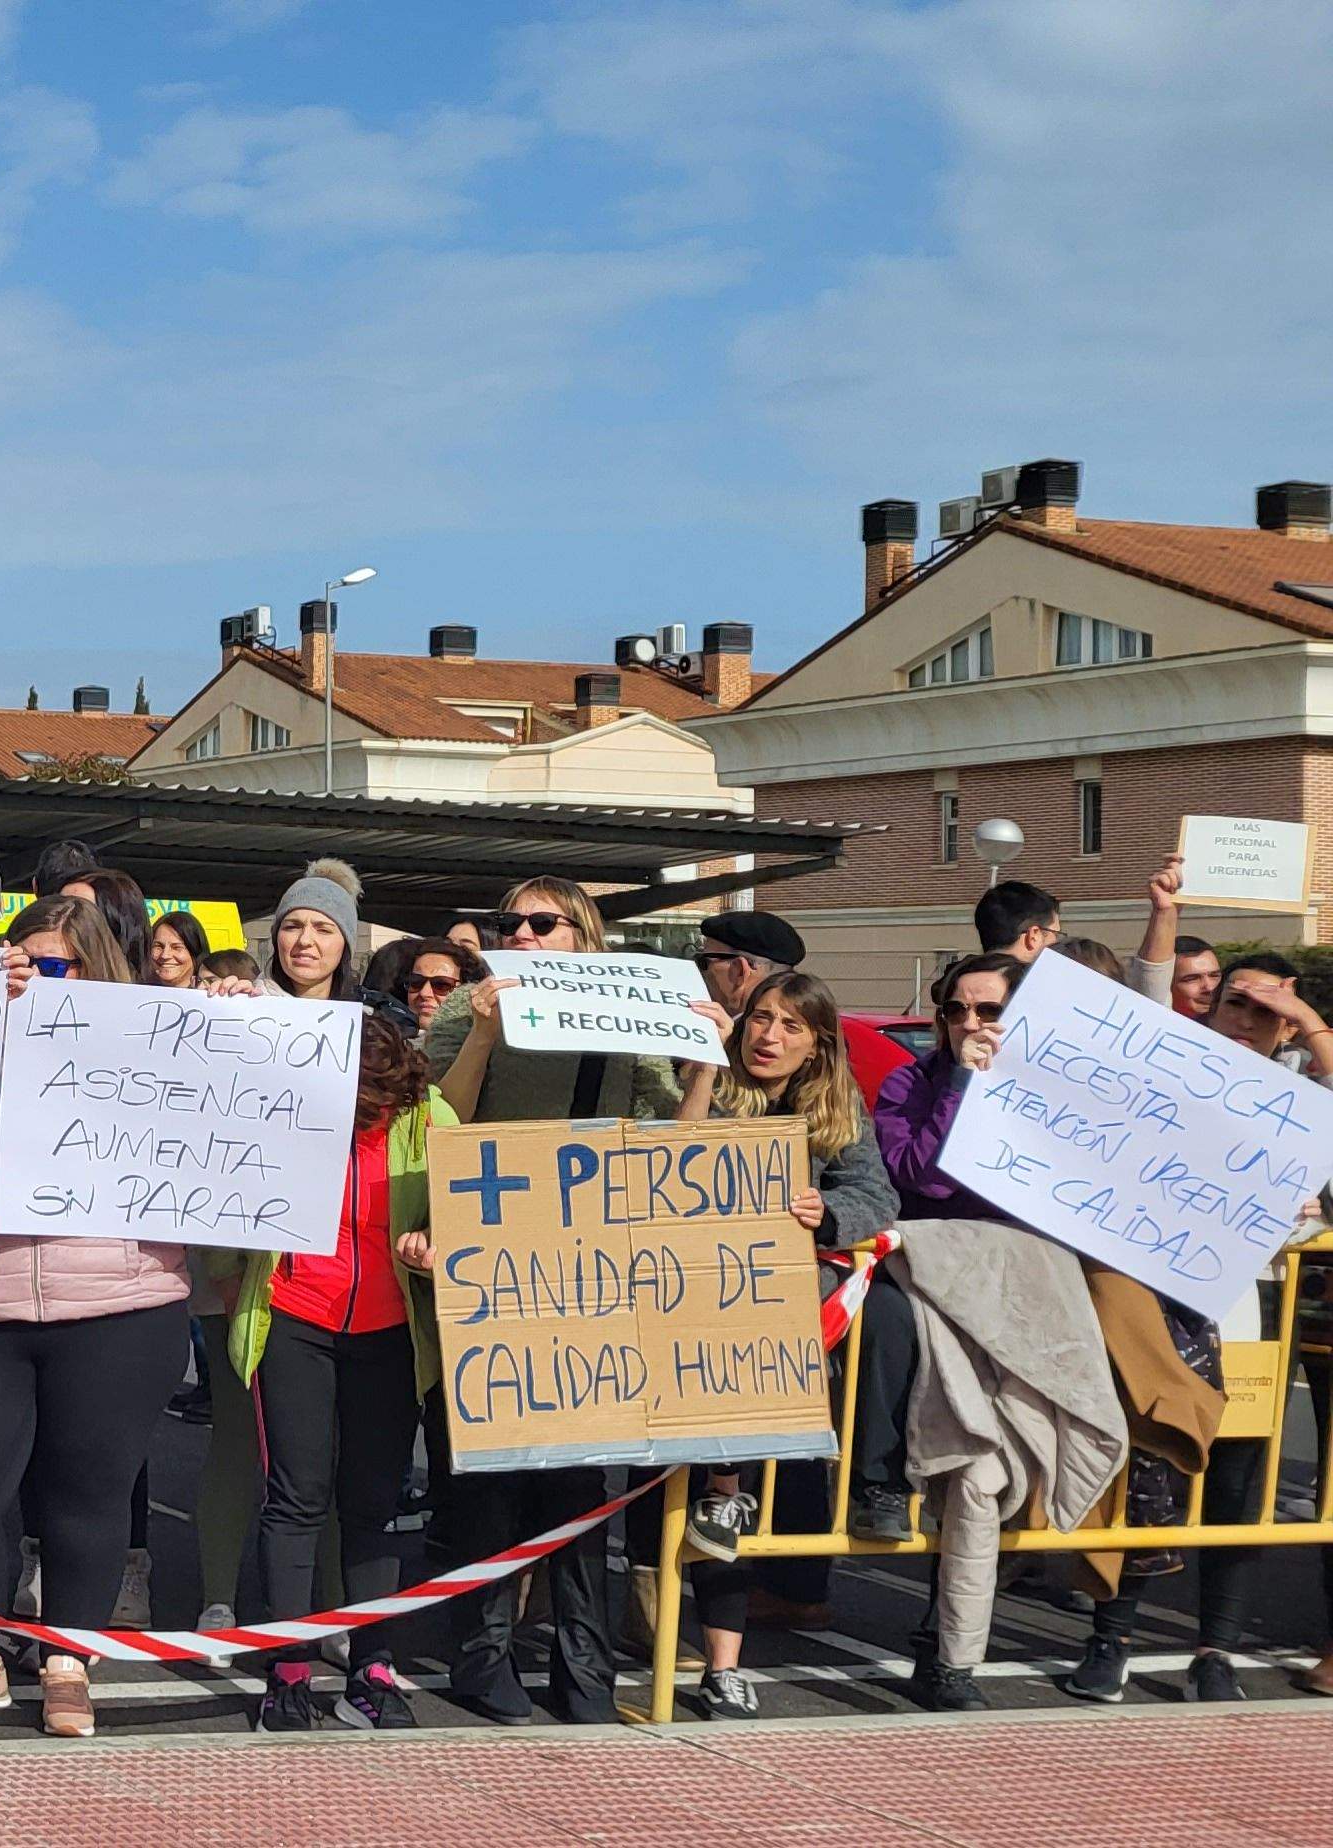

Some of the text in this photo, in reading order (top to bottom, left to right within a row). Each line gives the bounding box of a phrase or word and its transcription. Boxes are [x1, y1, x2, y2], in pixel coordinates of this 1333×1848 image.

[1214, 836, 1277, 848] PERSONAL
[1228, 852, 1260, 861] PARA
[1208, 865, 1278, 877] URGENCIAS
[518, 974, 692, 1008] HOSPITALES
[531, 960, 662, 980] MEJORES
[25, 991, 90, 1042] LA
[557, 1011, 708, 1045] RECURSOS
[1073, 994, 1311, 1137] HUESCA
[52, 1118, 282, 1180] AUMENTA
[975, 1139, 1050, 1186] DE
[1225, 1141, 1310, 1202] UNA
[116, 1174, 312, 1243] PARAR
[1139, 1152, 1292, 1249] URGENTE
[718, 1241, 785, 1312] DE
[674, 1337, 825, 1399] HUMANA
